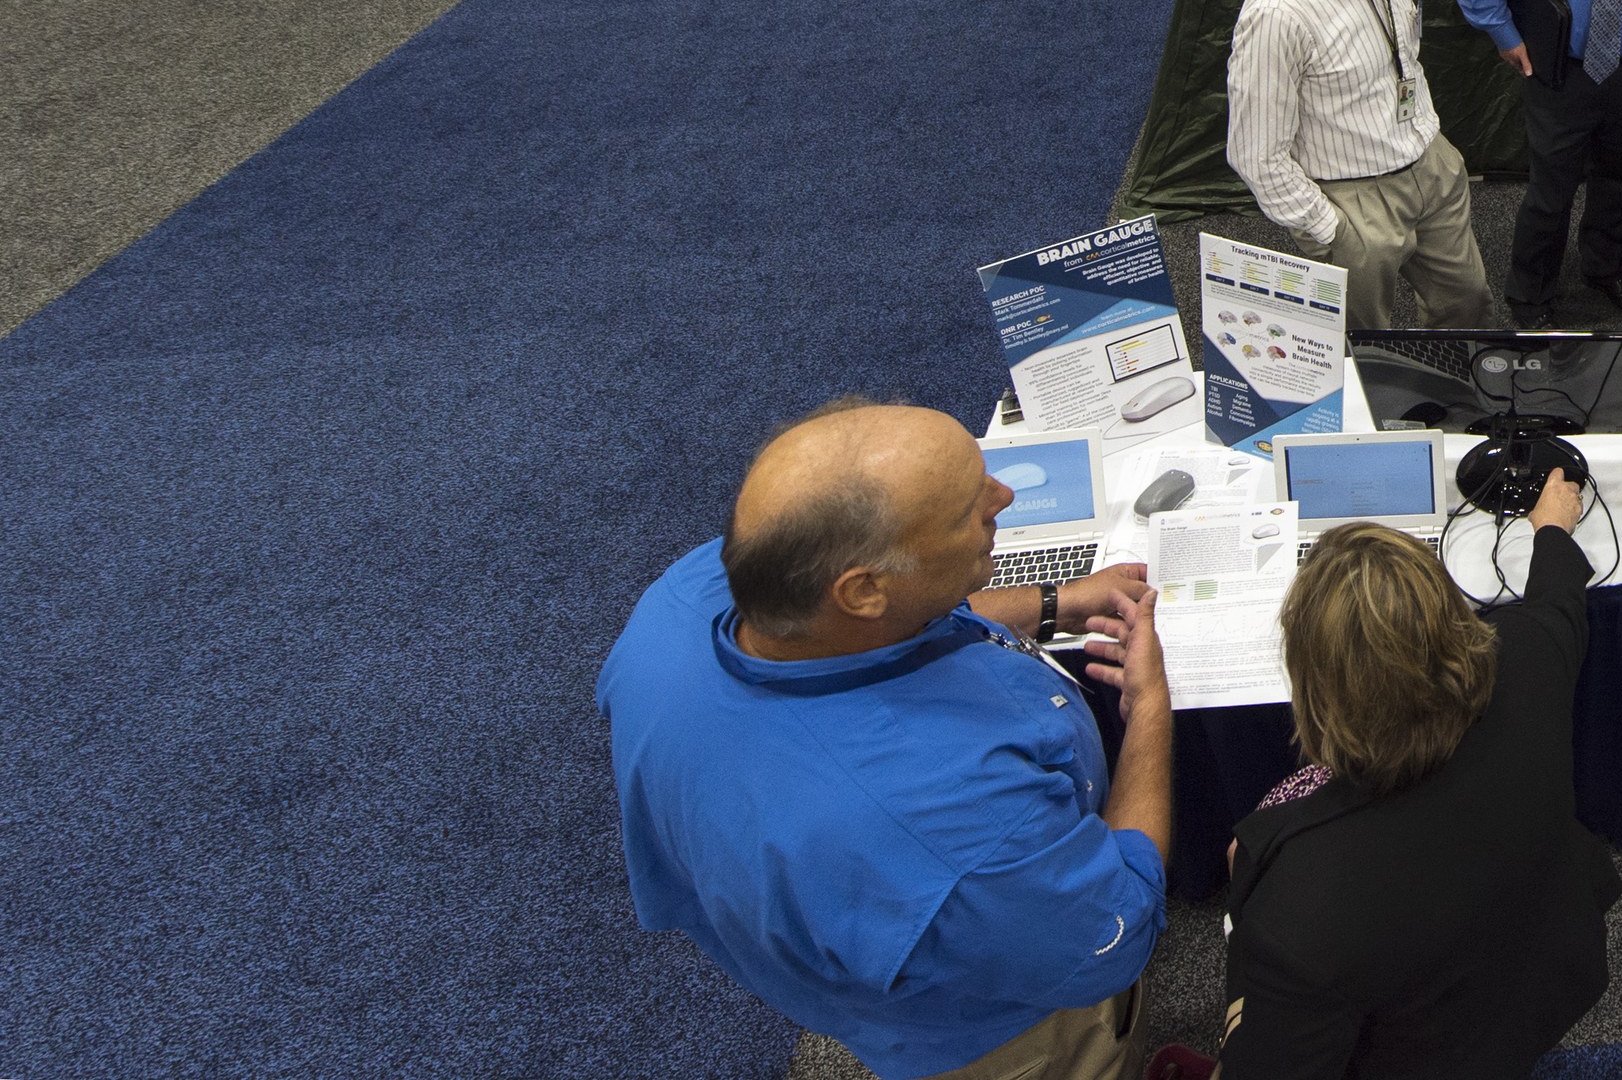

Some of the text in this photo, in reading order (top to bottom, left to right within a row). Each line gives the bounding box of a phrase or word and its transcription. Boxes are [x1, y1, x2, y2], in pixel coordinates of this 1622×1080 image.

[1036, 220, 1154, 266] BRAIN GAUGE
[1064, 234, 1156, 268] from corticalmetrics
[1082, 268, 1097, 276] Brain
[1098, 262, 1115, 273] Gauge
[1126, 250, 1153, 263] developed
[1086, 253, 1161, 280] address the need for reliable,
[1231, 245, 1311, 273] Tracking mTBI Recovery
[1102, 258, 1162, 281] efficient, objective and
[1106, 264, 1163, 286] quantitative measures
[1134, 274, 1148, 283] brain
[1148, 269, 1165, 279] health
[992, 285, 1046, 308] RESEARCH POC
[994, 308, 1009, 316] Mark
[1001, 320, 1032, 336] ONR POC
[1012, 333, 1023, 342] Tim
[1024, 327, 1044, 339] Bentley
[1292, 334, 1334, 352] New Ways to
[1297, 344, 1326, 359] Measure
[1292, 352, 1333, 370] Brain Health
[1209, 374, 1249, 390] APPLICATIONS
[1232, 398, 1252, 409] Migraine
[1236, 393, 1249, 403] Aging
[1207, 402, 1223, 411] Autism
[1231, 404, 1253, 415] Dementia
[1230, 410, 1255, 421] Concussion
[1015, 498, 1058, 512] GAUGE
